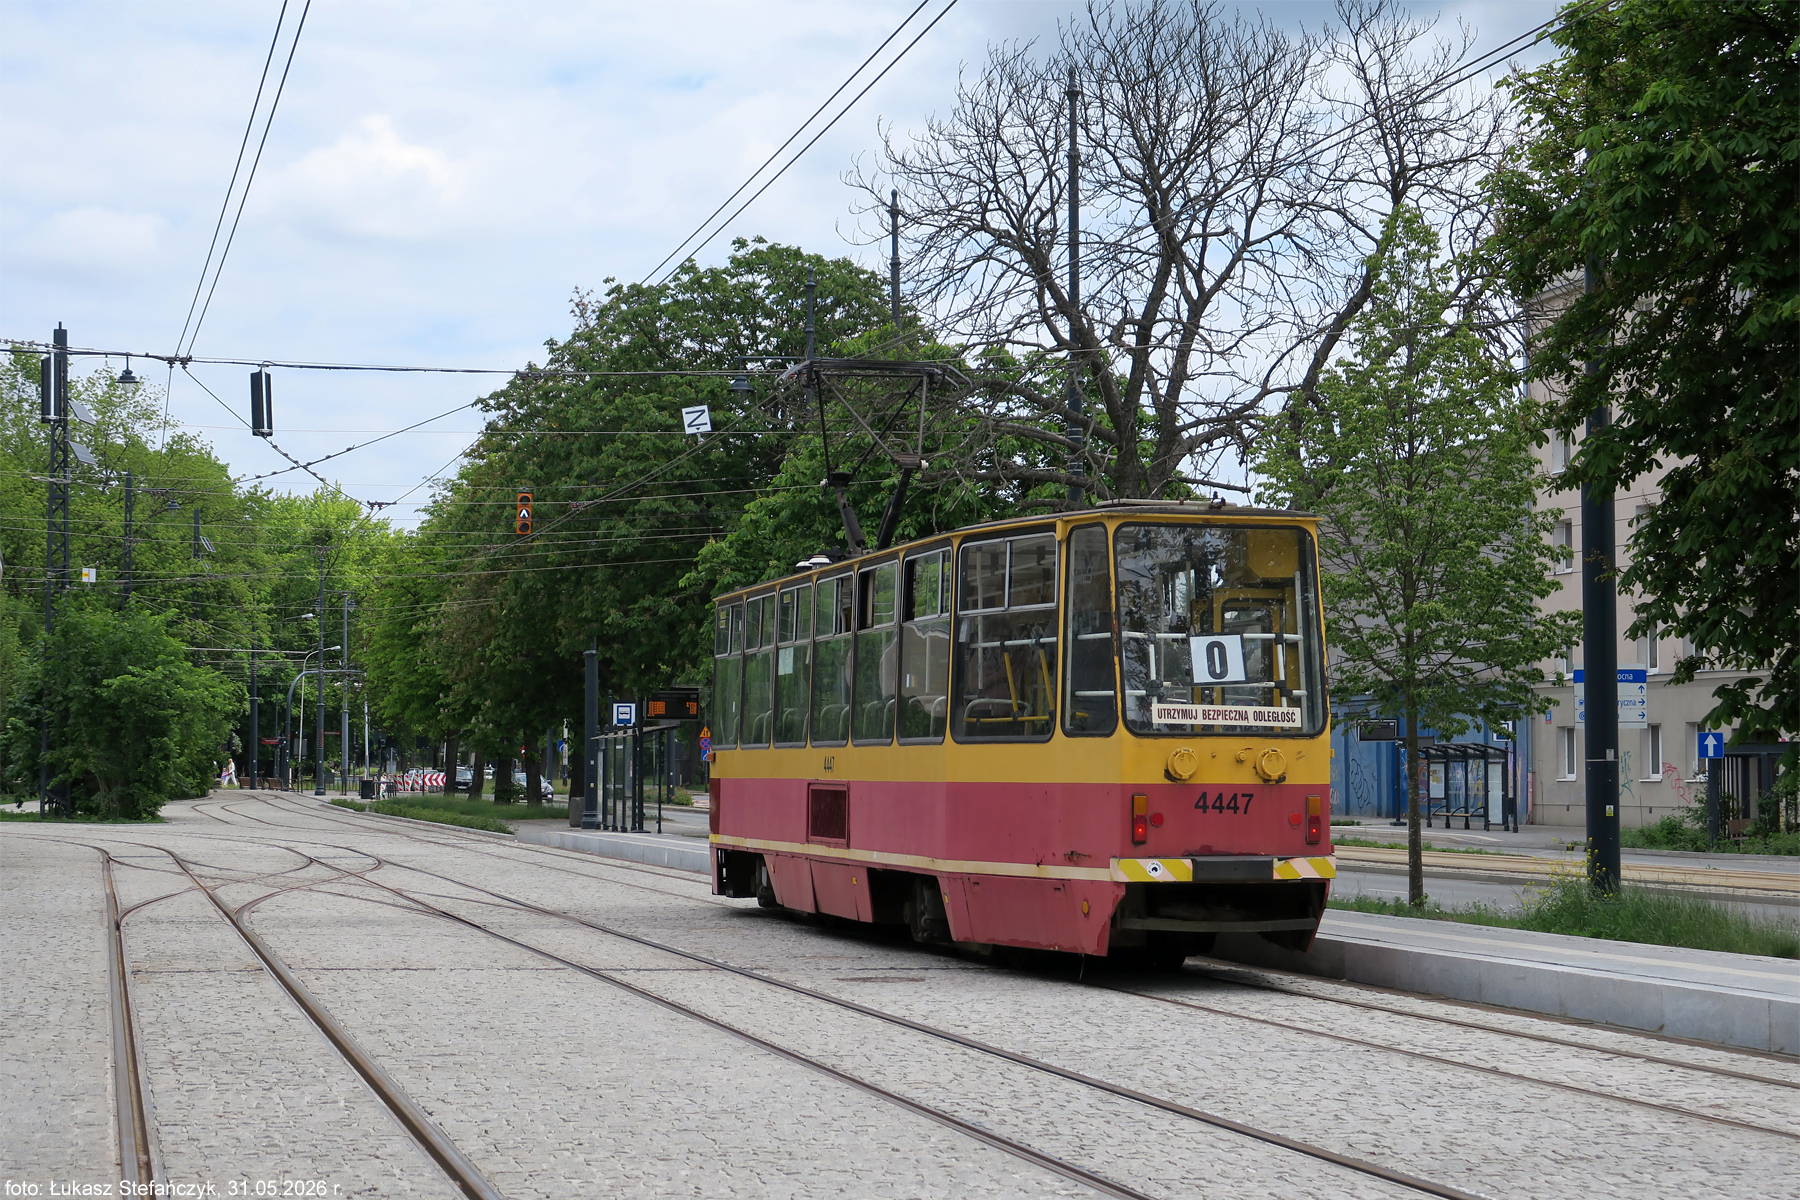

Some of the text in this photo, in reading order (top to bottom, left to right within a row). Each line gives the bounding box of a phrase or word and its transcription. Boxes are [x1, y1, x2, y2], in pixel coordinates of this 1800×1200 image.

[1157, 708, 1296, 723] UTRZYMUJ BEZPIECZNĄ ODLEGŁOŚĆ
[824, 756, 835, 773] 4447
[1194, 791, 1254, 815] 4447
